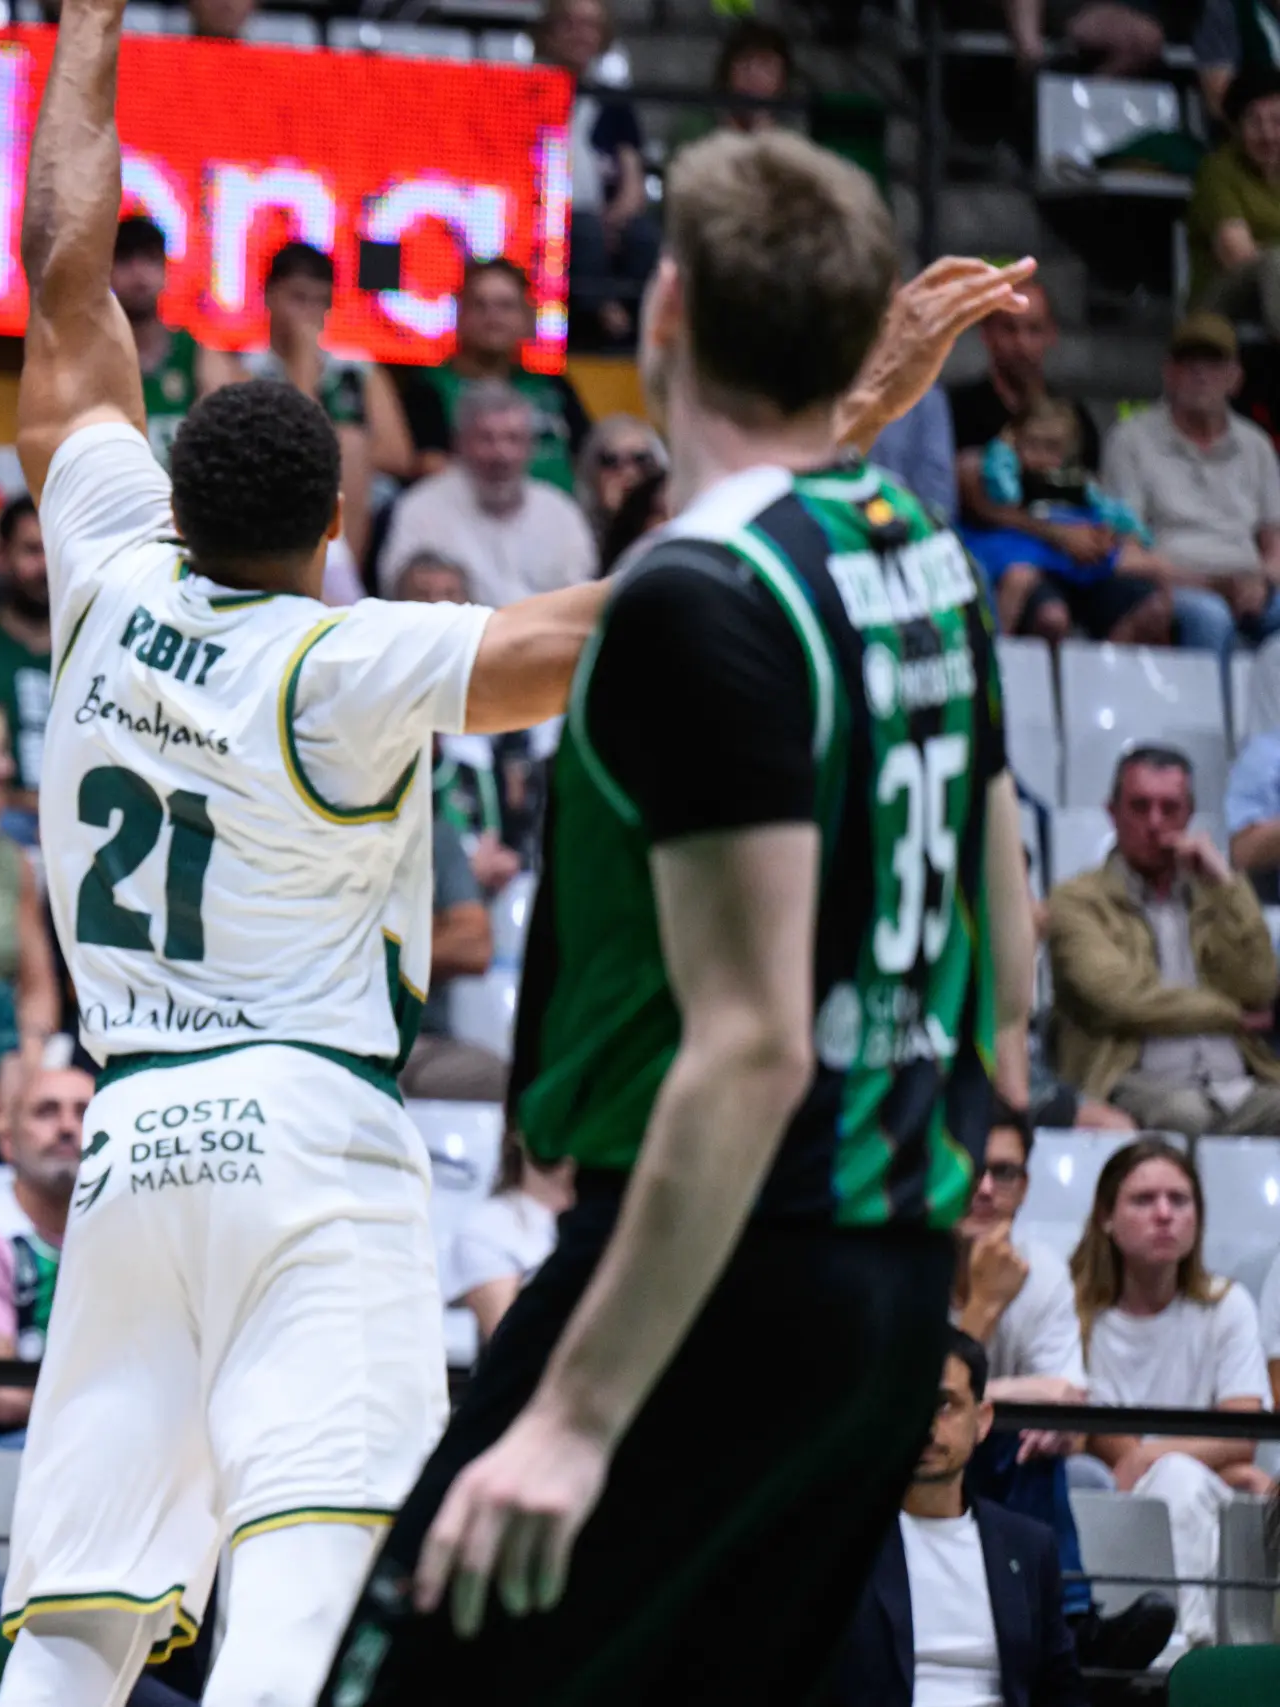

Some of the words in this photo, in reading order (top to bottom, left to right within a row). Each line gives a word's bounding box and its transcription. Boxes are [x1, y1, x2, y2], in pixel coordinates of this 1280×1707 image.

[76, 765, 216, 962] 21
[872, 733, 970, 976] 35
[134, 1098, 267, 1134] COSTA
[131, 1136, 191, 1163] DEL
[200, 1130, 265, 1155] SOL
[130, 1157, 263, 1195] MÁLAGA
